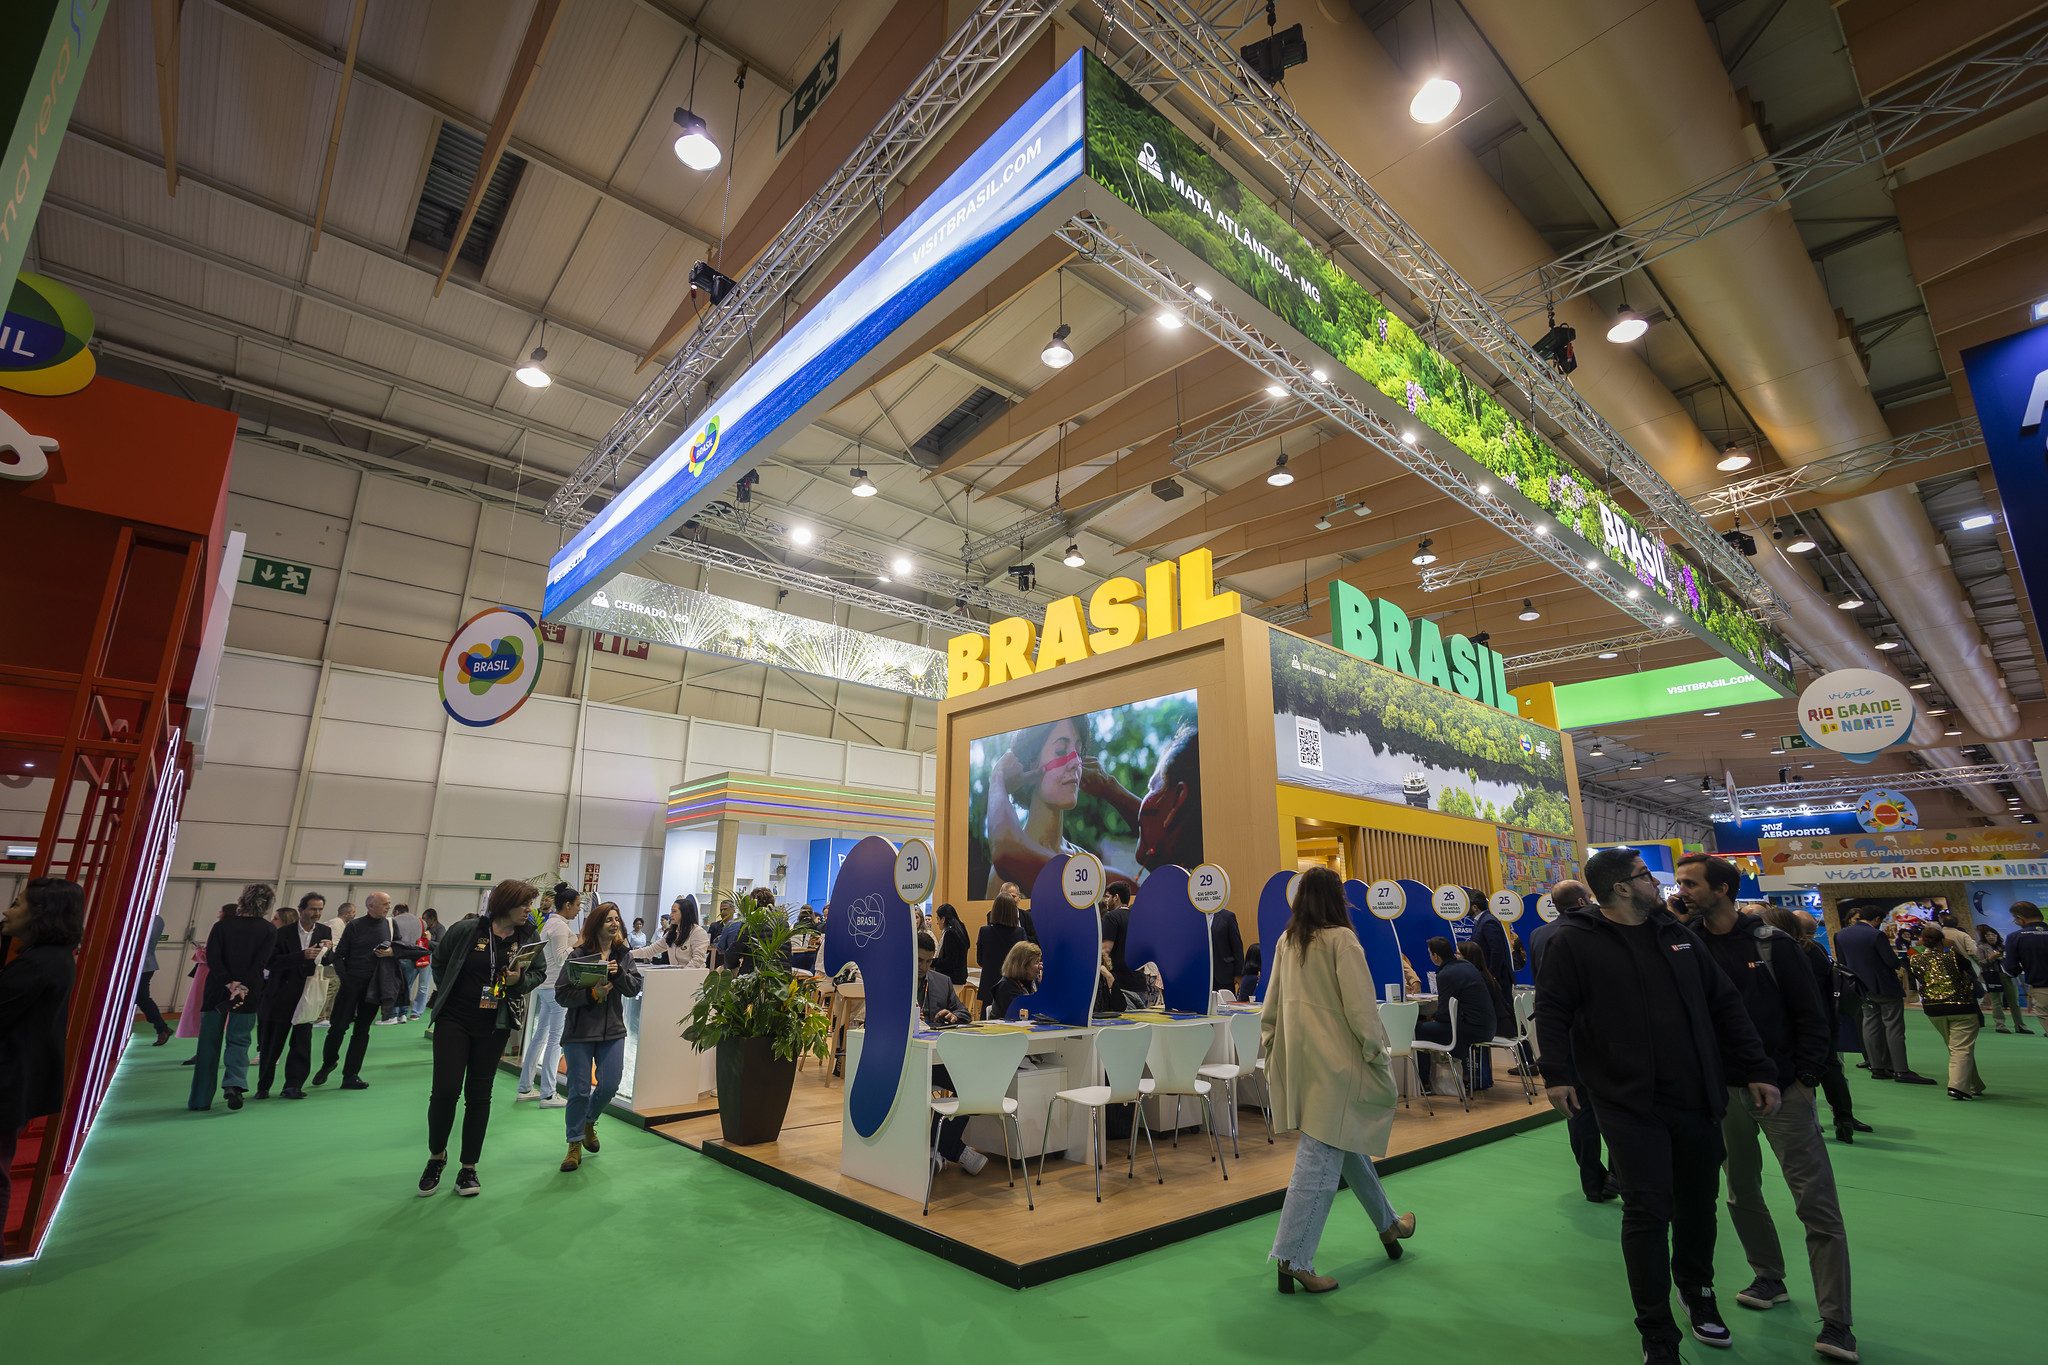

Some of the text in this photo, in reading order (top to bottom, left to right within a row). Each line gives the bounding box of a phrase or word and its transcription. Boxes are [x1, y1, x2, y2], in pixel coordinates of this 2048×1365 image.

[912, 136, 1042, 265] VISITBRASIL.COM
[1170, 171, 1214, 220] MATA
[1216, 210, 1293, 283] ATLÂNTICA
[1300, 276, 1321, 304] MG
[1598, 500, 1674, 591] BRASIL
[614, 600, 667, 619] CERRADO
[673, 614, 689, 624] GO
[946, 547, 1241, 698] BRASIL
[1329, 578, 1519, 716] BRASIL
[473, 659, 510, 673] BRASIL
[1666, 674, 1755, 695] VISITBRASIL.COM
[1828, 687, 1875, 700] visite
[1837, 699, 1901, 718] GRANDE
[1841, 715, 1895, 732] NORTE
[1763, 828, 1830, 838] AEROPORTOS
[1792, 843, 2041, 861] ACOLHEDOR E GRANDIOSO POR NATUREZA
[906, 856, 919, 872] 30
[1825, 867, 1892, 880] visite
[1921, 865, 1982, 879] GRANDE
[2005, 863, 2048, 876] NORT
[1075, 869, 1088, 881] 30
[1200, 875, 1213, 886] 29
[1378, 887, 1389, 897] 27
[1443, 892, 1455, 900] 26
[1499, 896, 1510, 904] 25
[856, 916, 877, 926] BRASIL
